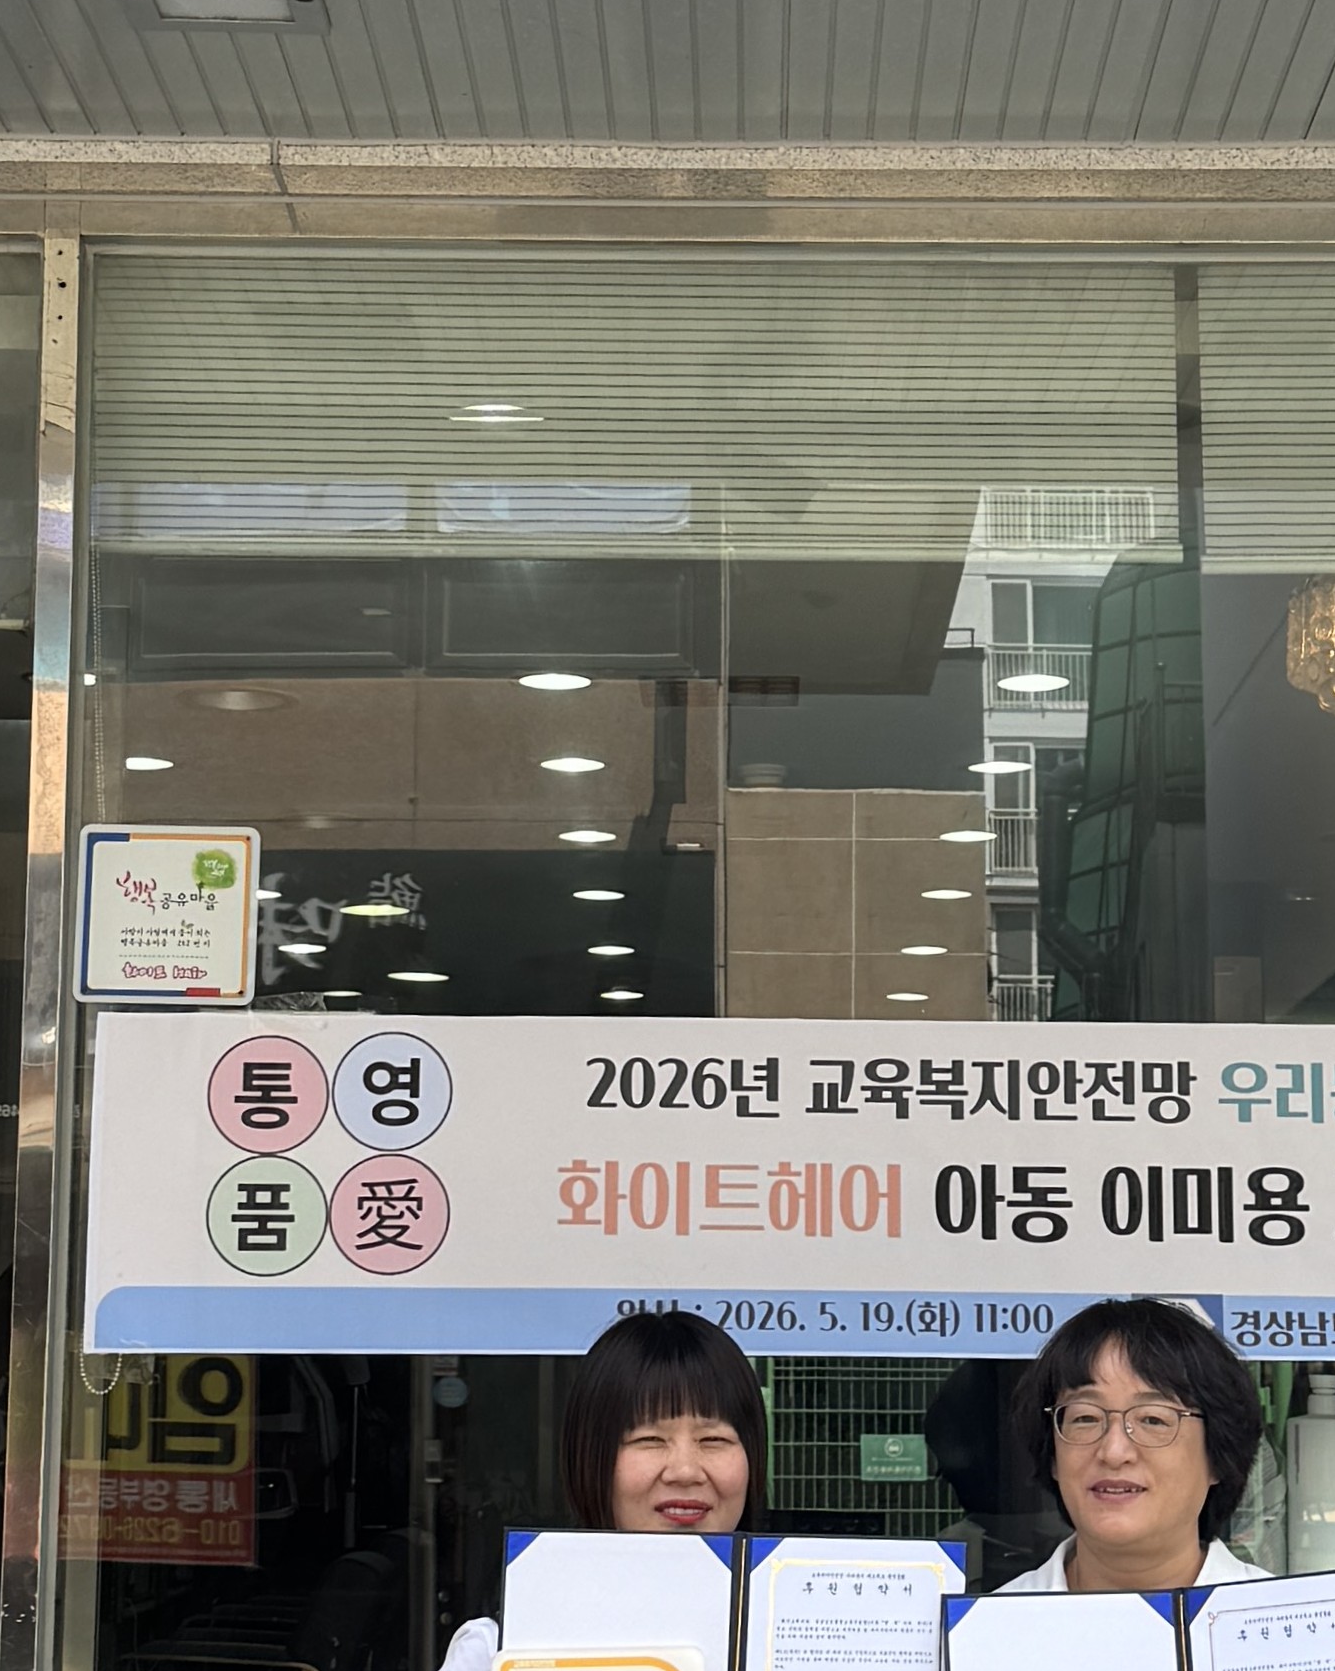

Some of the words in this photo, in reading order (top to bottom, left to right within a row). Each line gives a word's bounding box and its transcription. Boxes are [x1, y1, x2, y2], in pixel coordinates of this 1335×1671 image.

[116, 870, 157, 915] 행복
[160, 882, 218, 911] 공유마을
[233, 1061, 300, 1128] 통
[361, 1058, 423, 1128] 영
[586, 1057, 781, 1119] 2026년
[805, 1058, 1197, 1125] 교육복지안전망
[231, 1182, 296, 1253] 품
[356, 1179, 425, 1253] 愛
[556, 1158, 903, 1239] 화이트헤어
[934, 1163, 1074, 1246] 아동
[1100, 1164, 1311, 1247] 이미용
[714, 1300, 806, 1332] 2026.
[818, 1300, 847, 1332] 5.
[861, 1299, 960, 1337] 19.(화)
[973, 1302, 1055, 1335] 11:00
